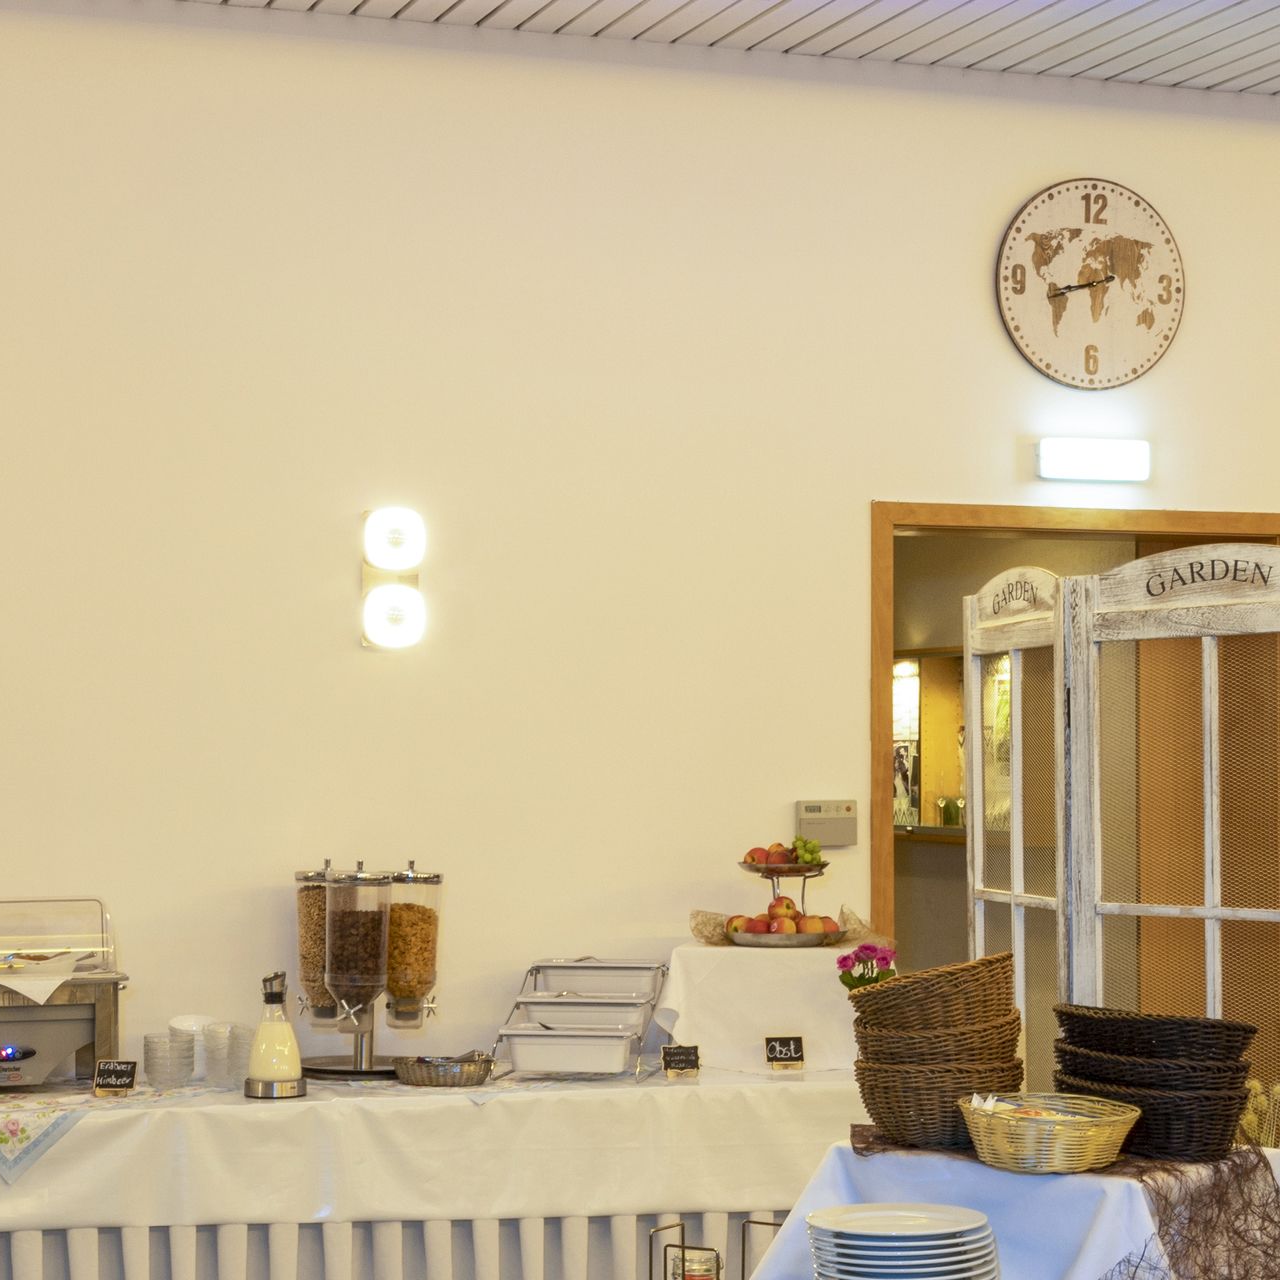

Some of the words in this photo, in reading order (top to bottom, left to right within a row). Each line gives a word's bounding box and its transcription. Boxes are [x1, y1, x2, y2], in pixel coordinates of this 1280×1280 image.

[1081, 193, 1108, 225] 12
[1011, 264, 1026, 295] 9
[1157, 274, 1172, 305] 3
[1084, 344, 1099, 376] 6
[1145, 558, 1273, 597] GARDEN
[992, 580, 1039, 615] GARDEN
[767, 1040, 802, 1058] Obst
[96, 1074, 132, 1085] Himbeer
